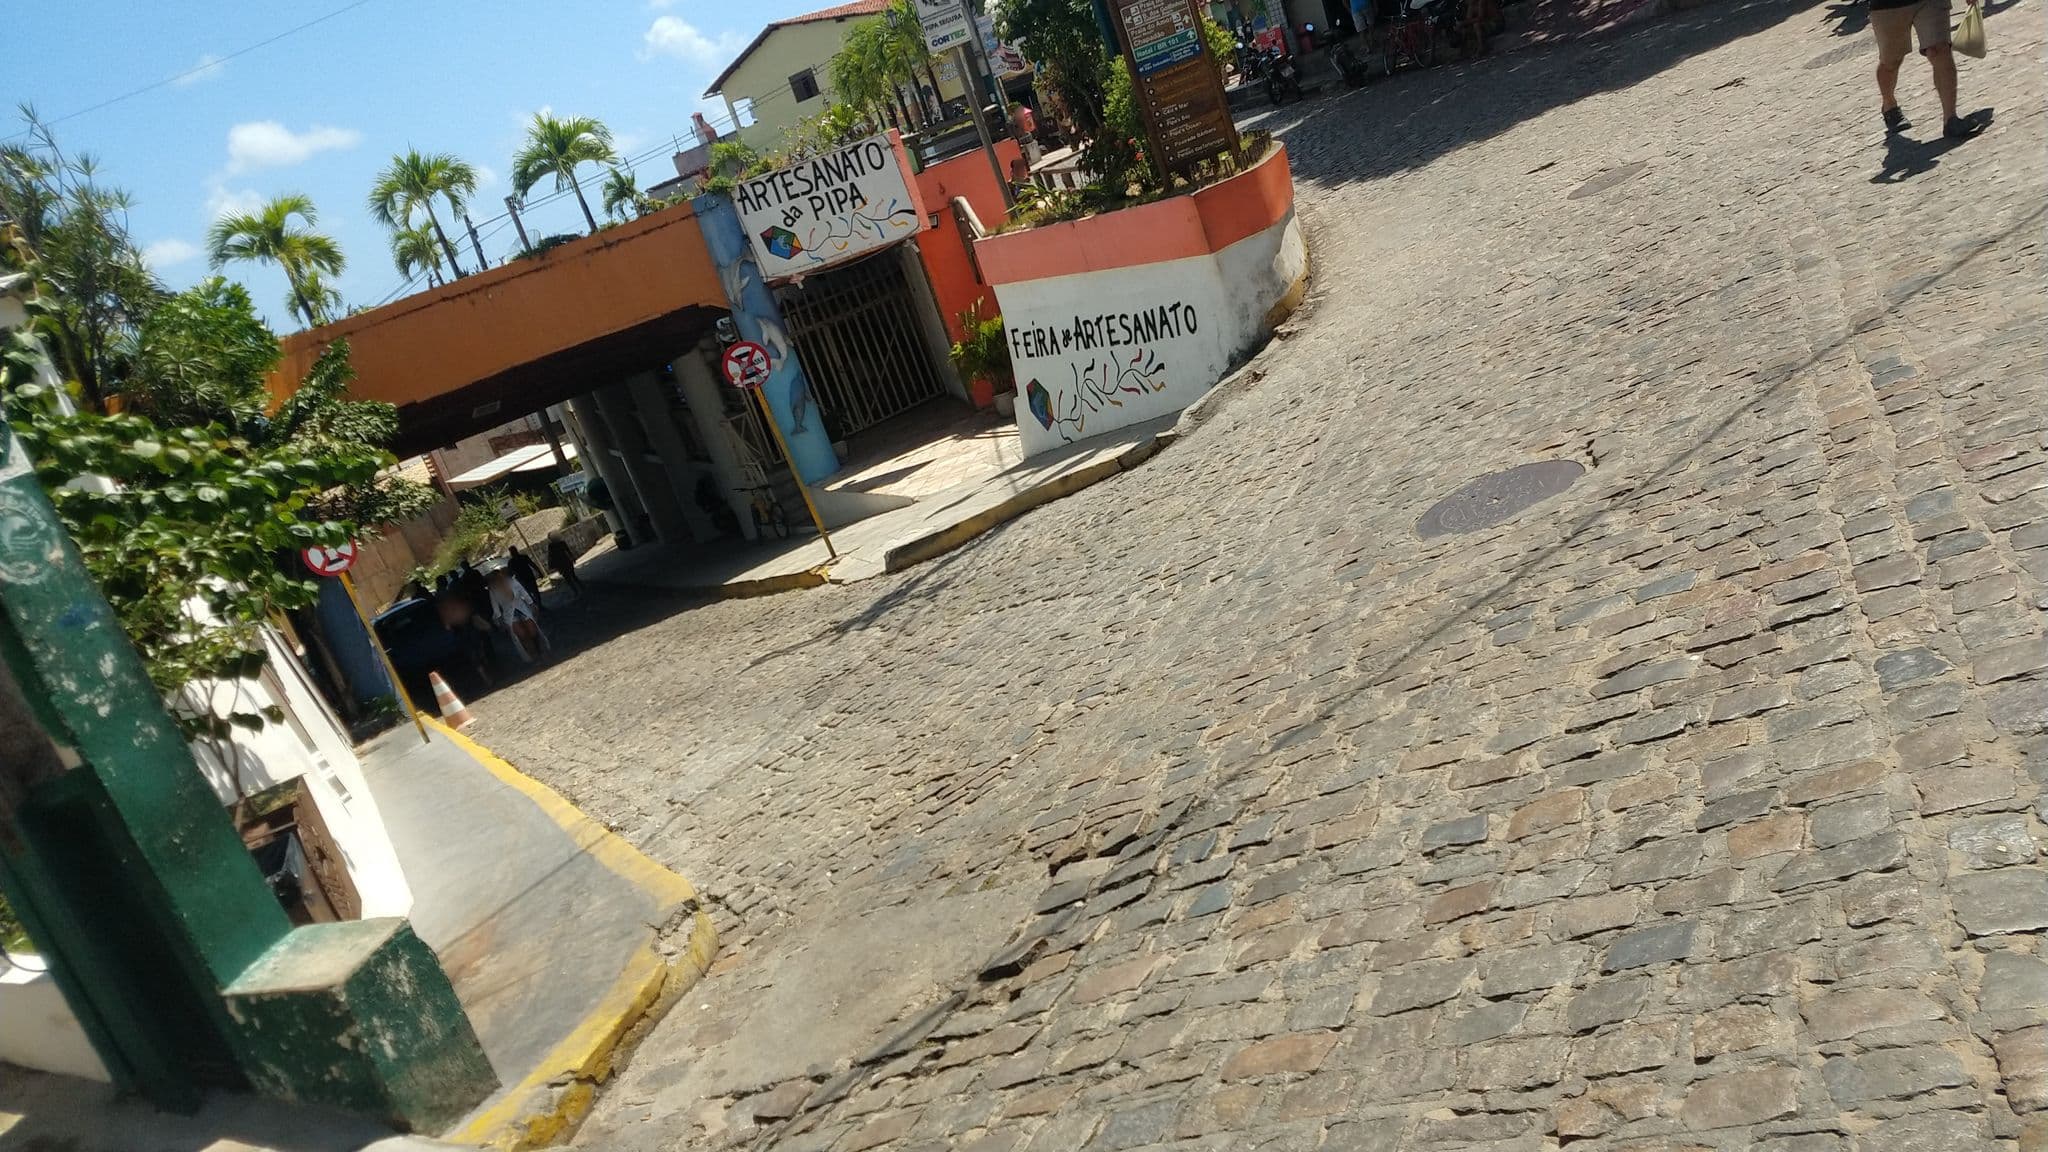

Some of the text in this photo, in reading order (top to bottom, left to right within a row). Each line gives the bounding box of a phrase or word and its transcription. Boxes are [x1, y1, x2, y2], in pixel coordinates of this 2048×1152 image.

[932, 29, 967, 46] CORTEZ
[737, 142, 885, 216] ARTESANATO
[781, 182, 867, 228] da PIPA
[1062, 327, 1073, 348] de
[1074, 301, 1197, 351] ARTESANATO
